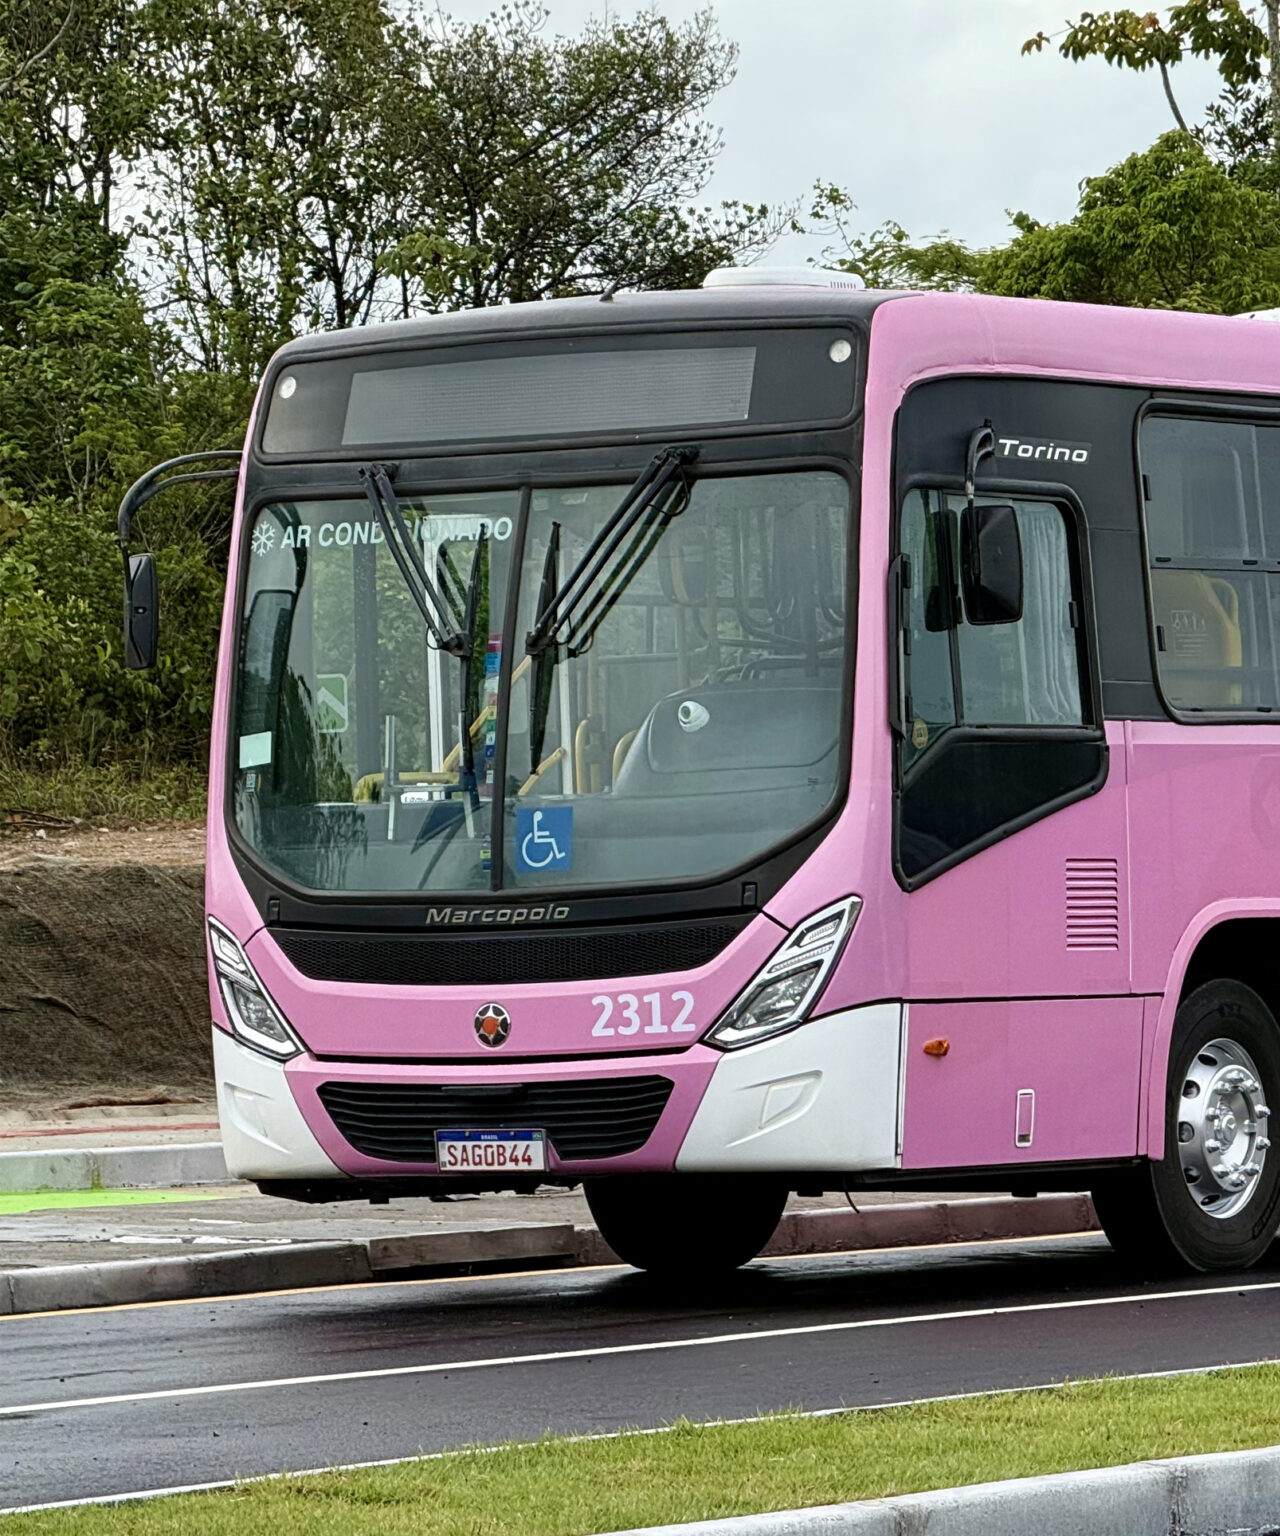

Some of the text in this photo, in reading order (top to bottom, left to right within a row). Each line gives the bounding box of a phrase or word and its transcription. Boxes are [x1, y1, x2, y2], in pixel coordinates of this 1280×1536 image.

[999, 439, 1088, 462] Torino
[281, 525, 311, 549] AR
[425, 904, 570, 924] Marcopolo
[591, 990, 696, 1037] 2312
